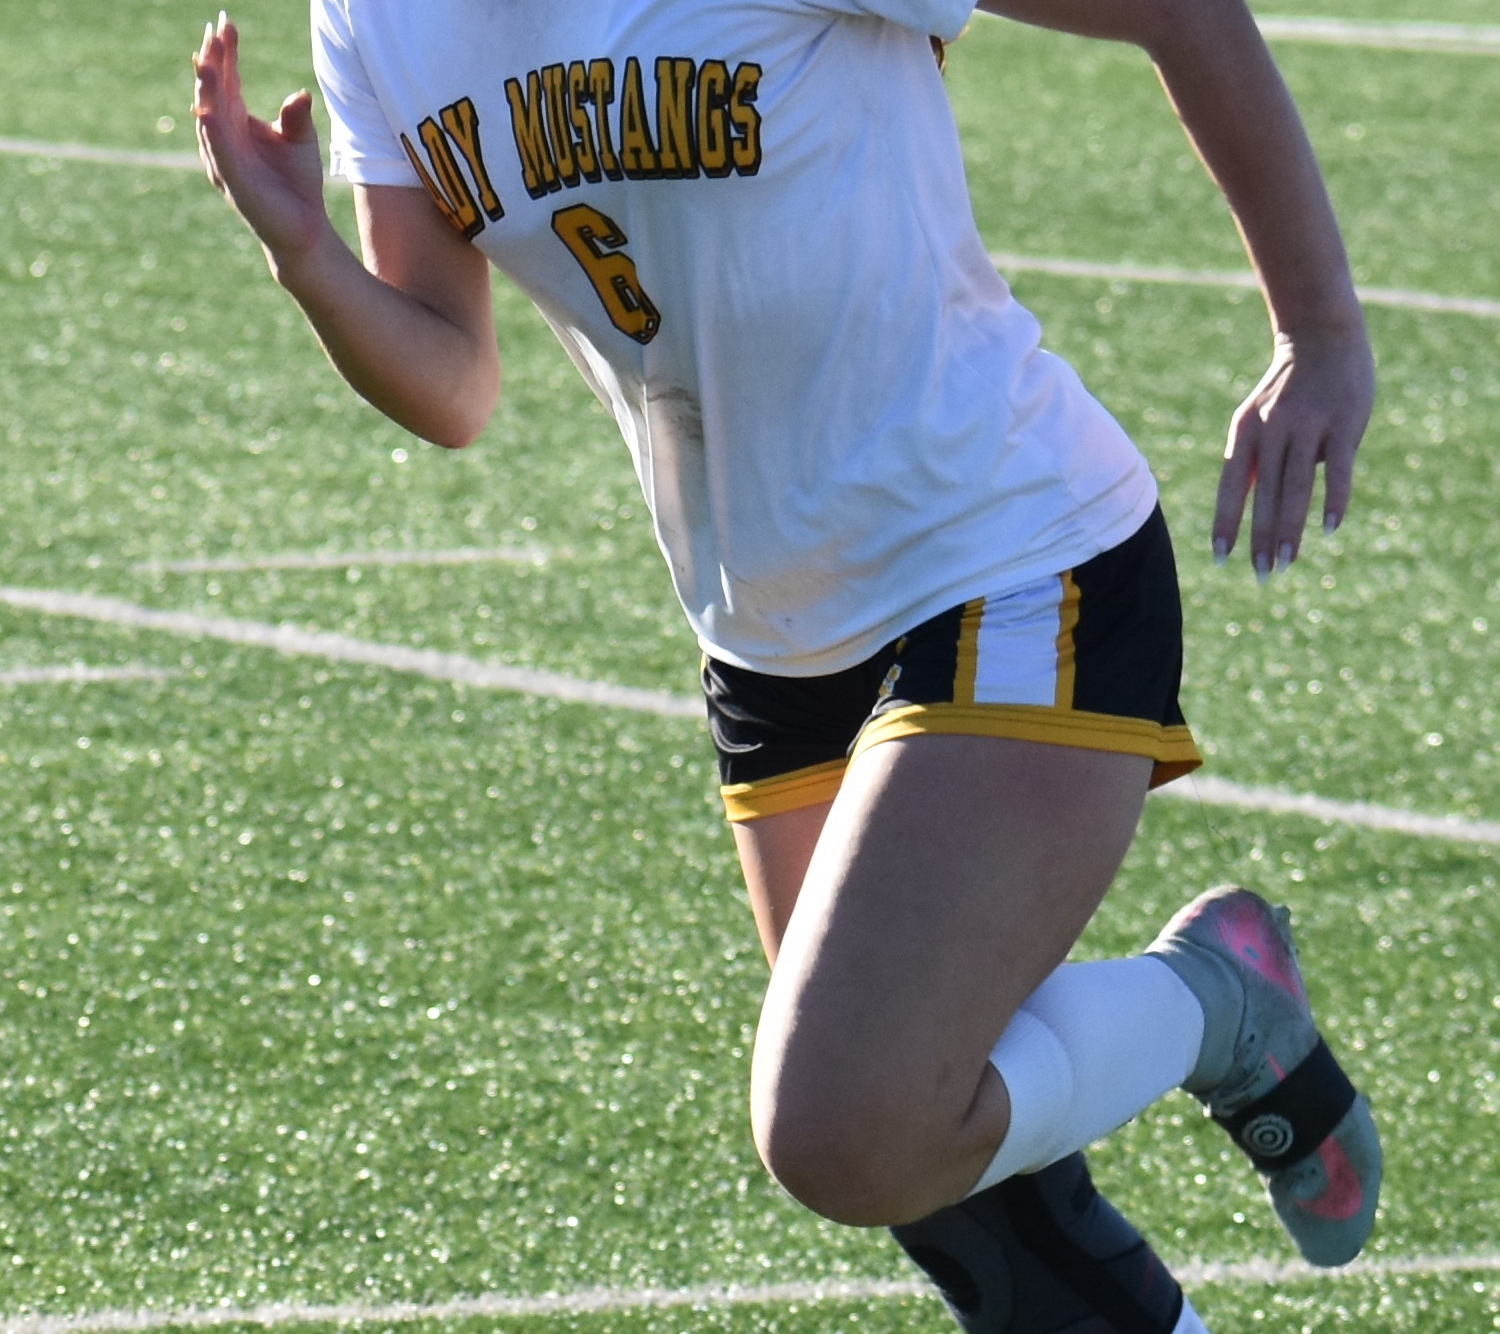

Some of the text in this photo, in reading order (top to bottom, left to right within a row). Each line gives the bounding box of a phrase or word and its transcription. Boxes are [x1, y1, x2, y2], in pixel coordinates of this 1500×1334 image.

[400, 56, 763, 243] DY MUSTANGS
[551, 203, 662, 346] 6
